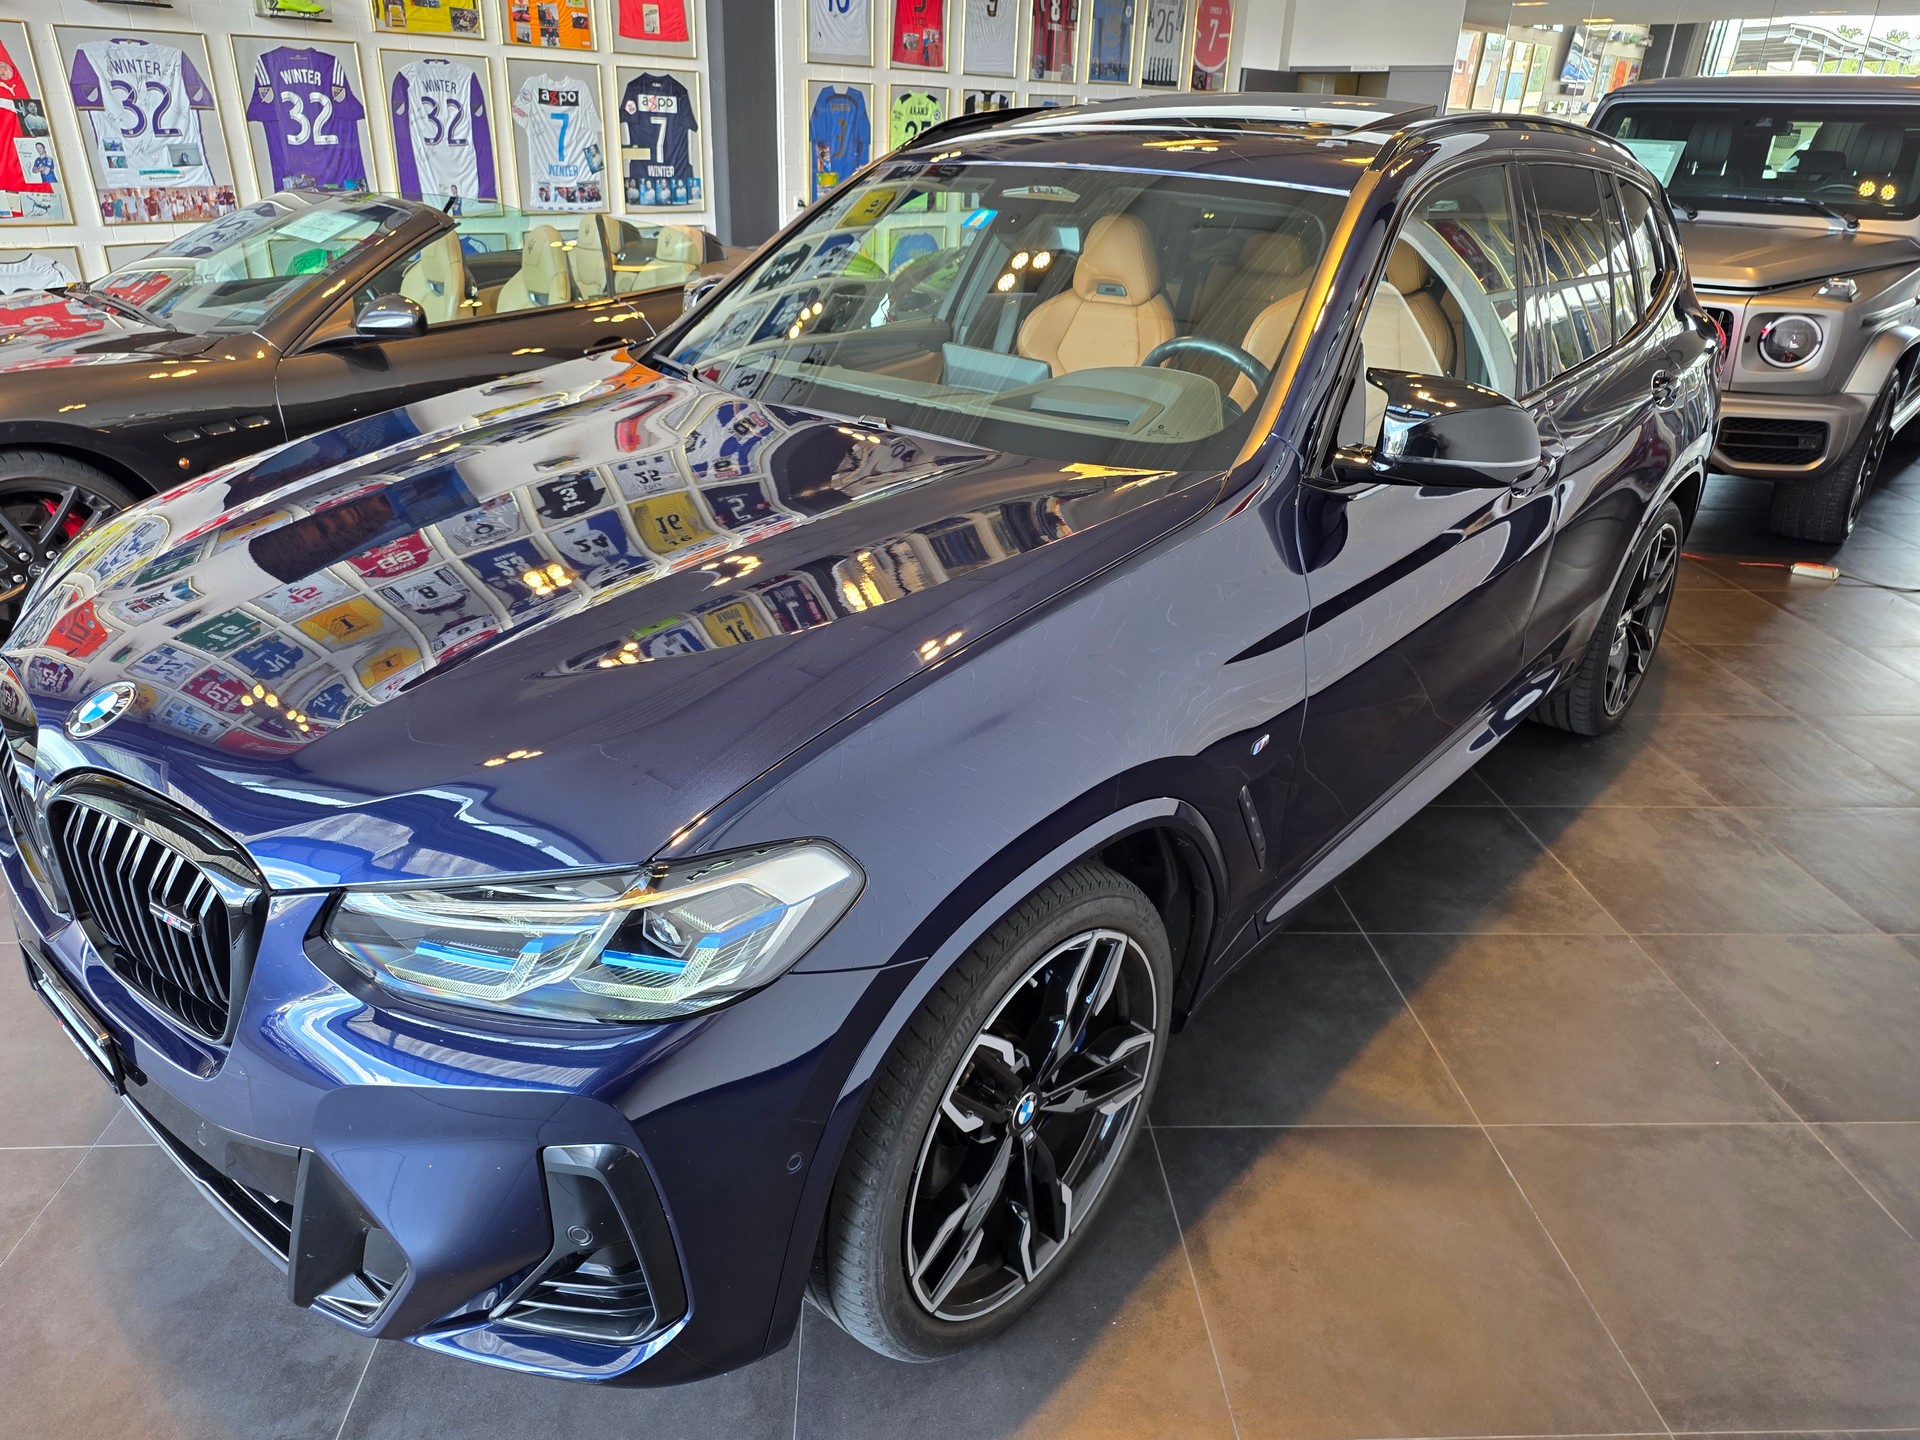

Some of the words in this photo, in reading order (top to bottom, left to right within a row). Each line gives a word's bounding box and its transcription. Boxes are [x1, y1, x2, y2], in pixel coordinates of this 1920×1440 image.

[1155, 8, 1175, 44] 26
[1209, 19, 1220, 52] 7
[110, 59, 162, 76] WINTER
[280, 68, 322, 86] WINTER
[422, 79, 457, 94] WINTER
[110, 80, 183, 138] 32
[280, 91, 339, 145] 32
[421, 96, 469, 147] 32
[550, 112, 569, 162] 7
[650, 116, 668, 164] 7
[548, 164, 579, 177] WINTER
[647, 165, 675, 178] WINTER
